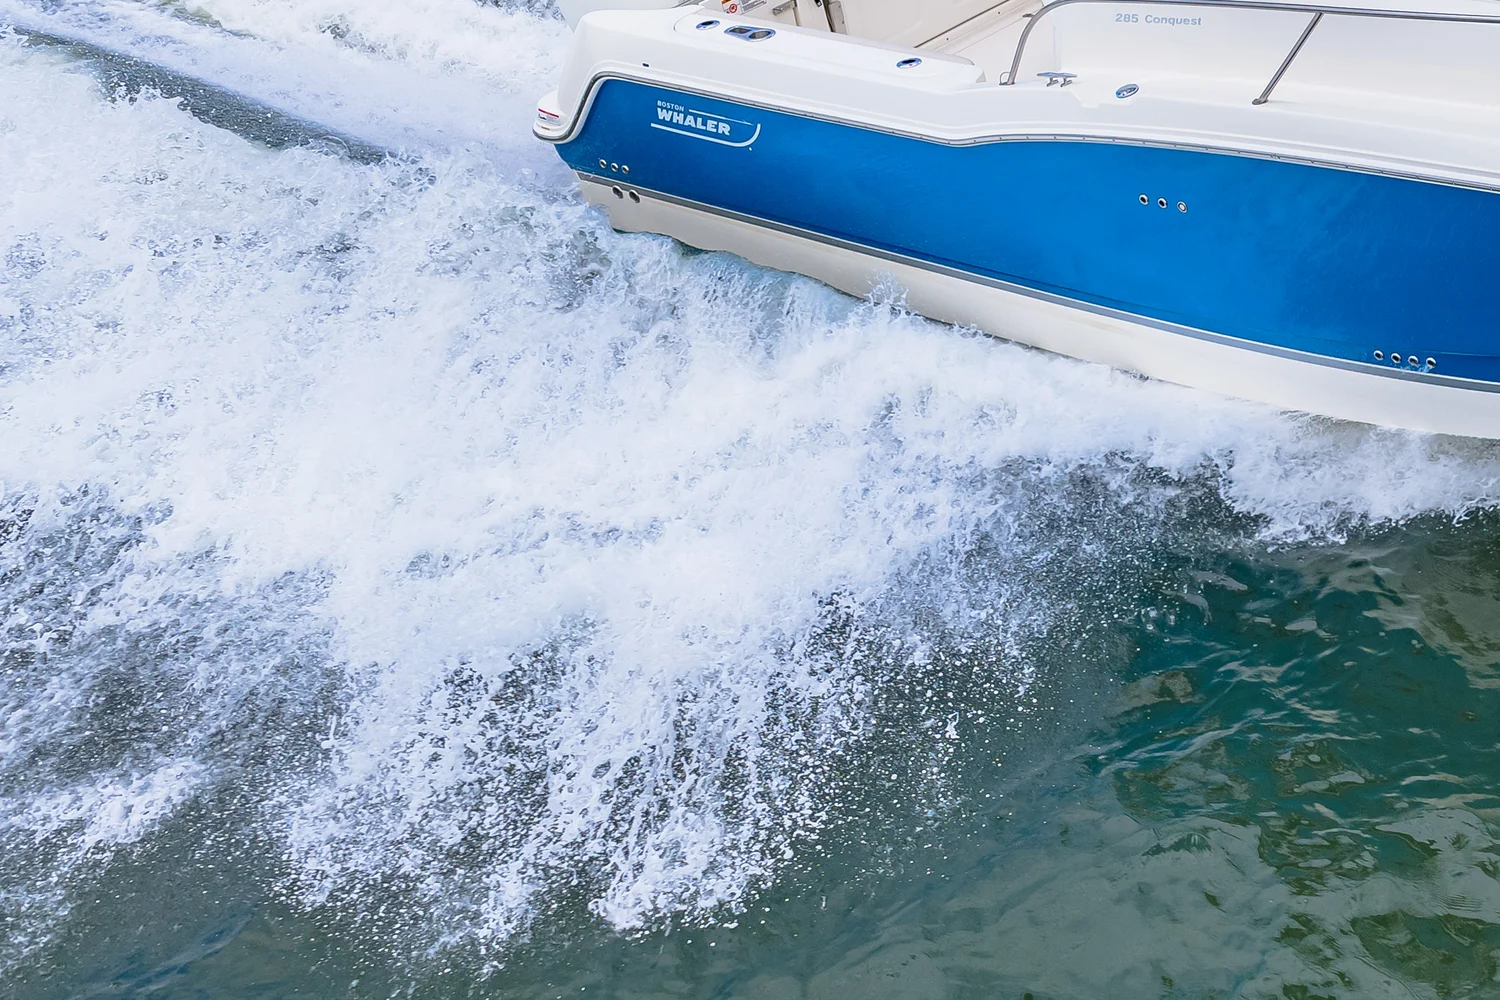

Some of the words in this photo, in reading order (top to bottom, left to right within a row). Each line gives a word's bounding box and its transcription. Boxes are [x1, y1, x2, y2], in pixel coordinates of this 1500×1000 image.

[1115, 12, 1139, 24] 285
[1144, 14, 1202, 27] Conquest
[656, 100, 685, 112] BOSTON
[656, 107, 731, 136] WHALER
